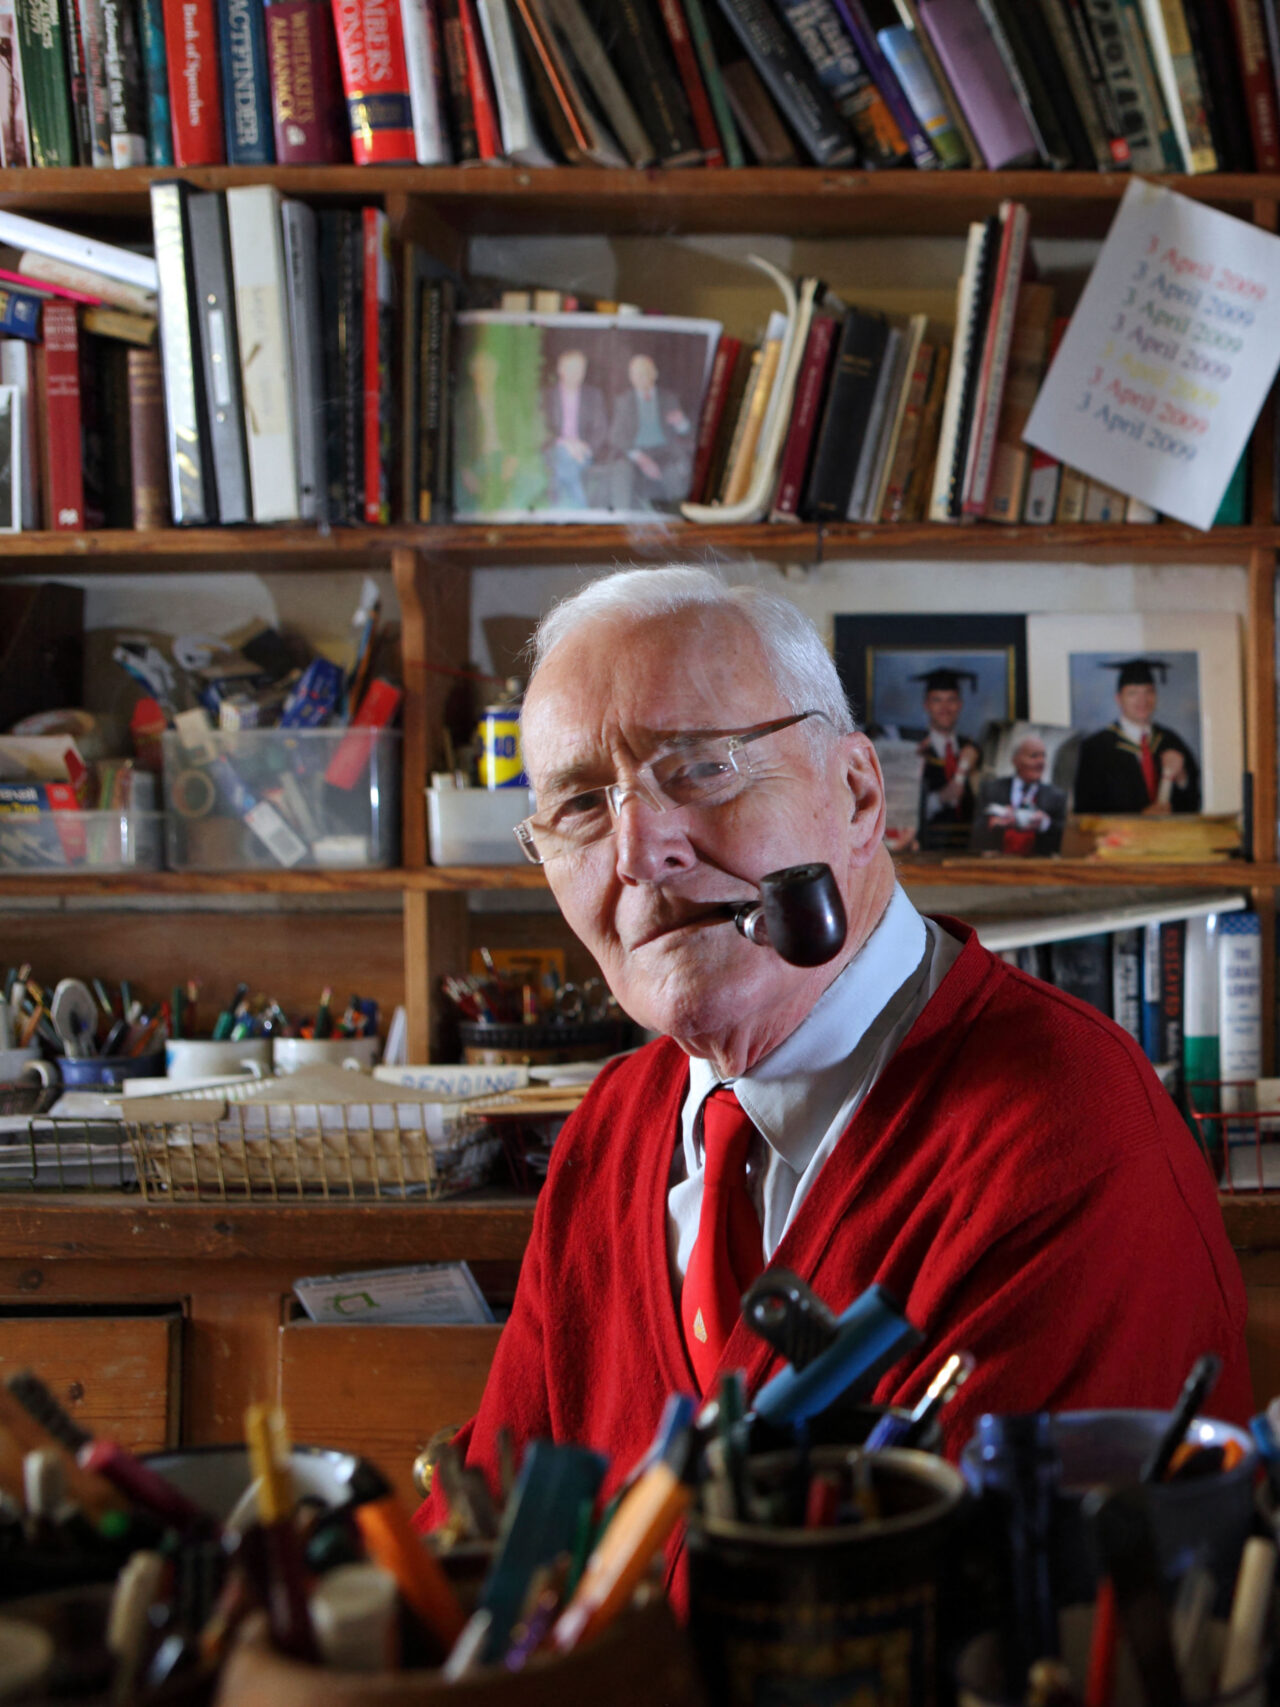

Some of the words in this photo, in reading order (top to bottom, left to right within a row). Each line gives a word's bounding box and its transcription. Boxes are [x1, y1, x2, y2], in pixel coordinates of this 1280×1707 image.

[183, 3, 199, 41] Book
[184, 57, 204, 126] Speeches
[271, 15, 295, 124] ALMANACK
[1161, 246, 1213, 283] April
[1134, 261, 1148, 281] 3
[1150, 272, 1202, 308] April
[1206, 296, 1254, 329] 2009
[1113, 314, 1125, 332] 3
[1127, 325, 1179, 362] April
[1182, 349, 1231, 383] 2009
[1139, 299, 1190, 336] April
[1193, 322, 1242, 355] 2009
[1090, 367, 1103, 386] 3
[1105, 377, 1157, 414] April
[1093, 403, 1145, 442] April
[1148, 428, 1197, 462] 2009
[400, 1070, 518, 1097] PENDING
